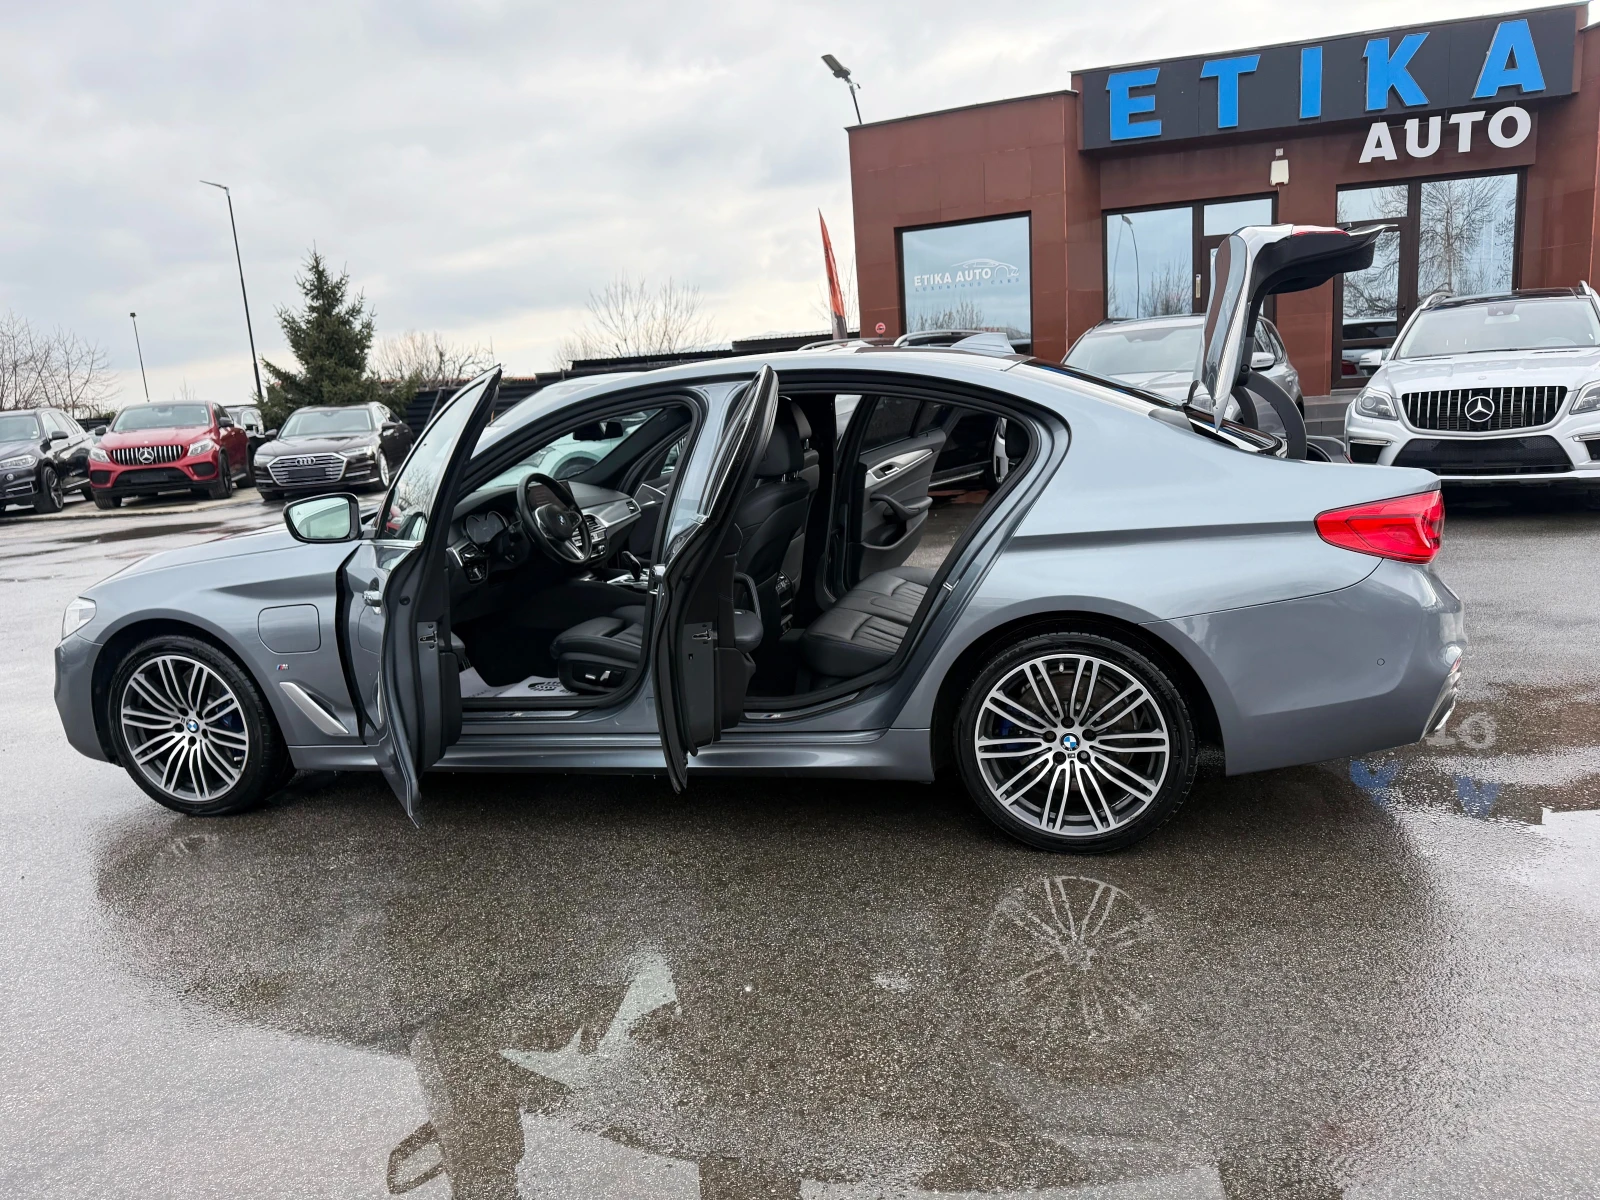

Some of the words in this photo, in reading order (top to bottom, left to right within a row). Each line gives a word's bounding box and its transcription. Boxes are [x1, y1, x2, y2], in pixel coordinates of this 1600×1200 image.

[1106, 18, 1546, 141] ETIKA
[1358, 106, 1531, 163] AUTO
[914, 272, 952, 287] ETIKA
[955, 268, 992, 282] AUTO
